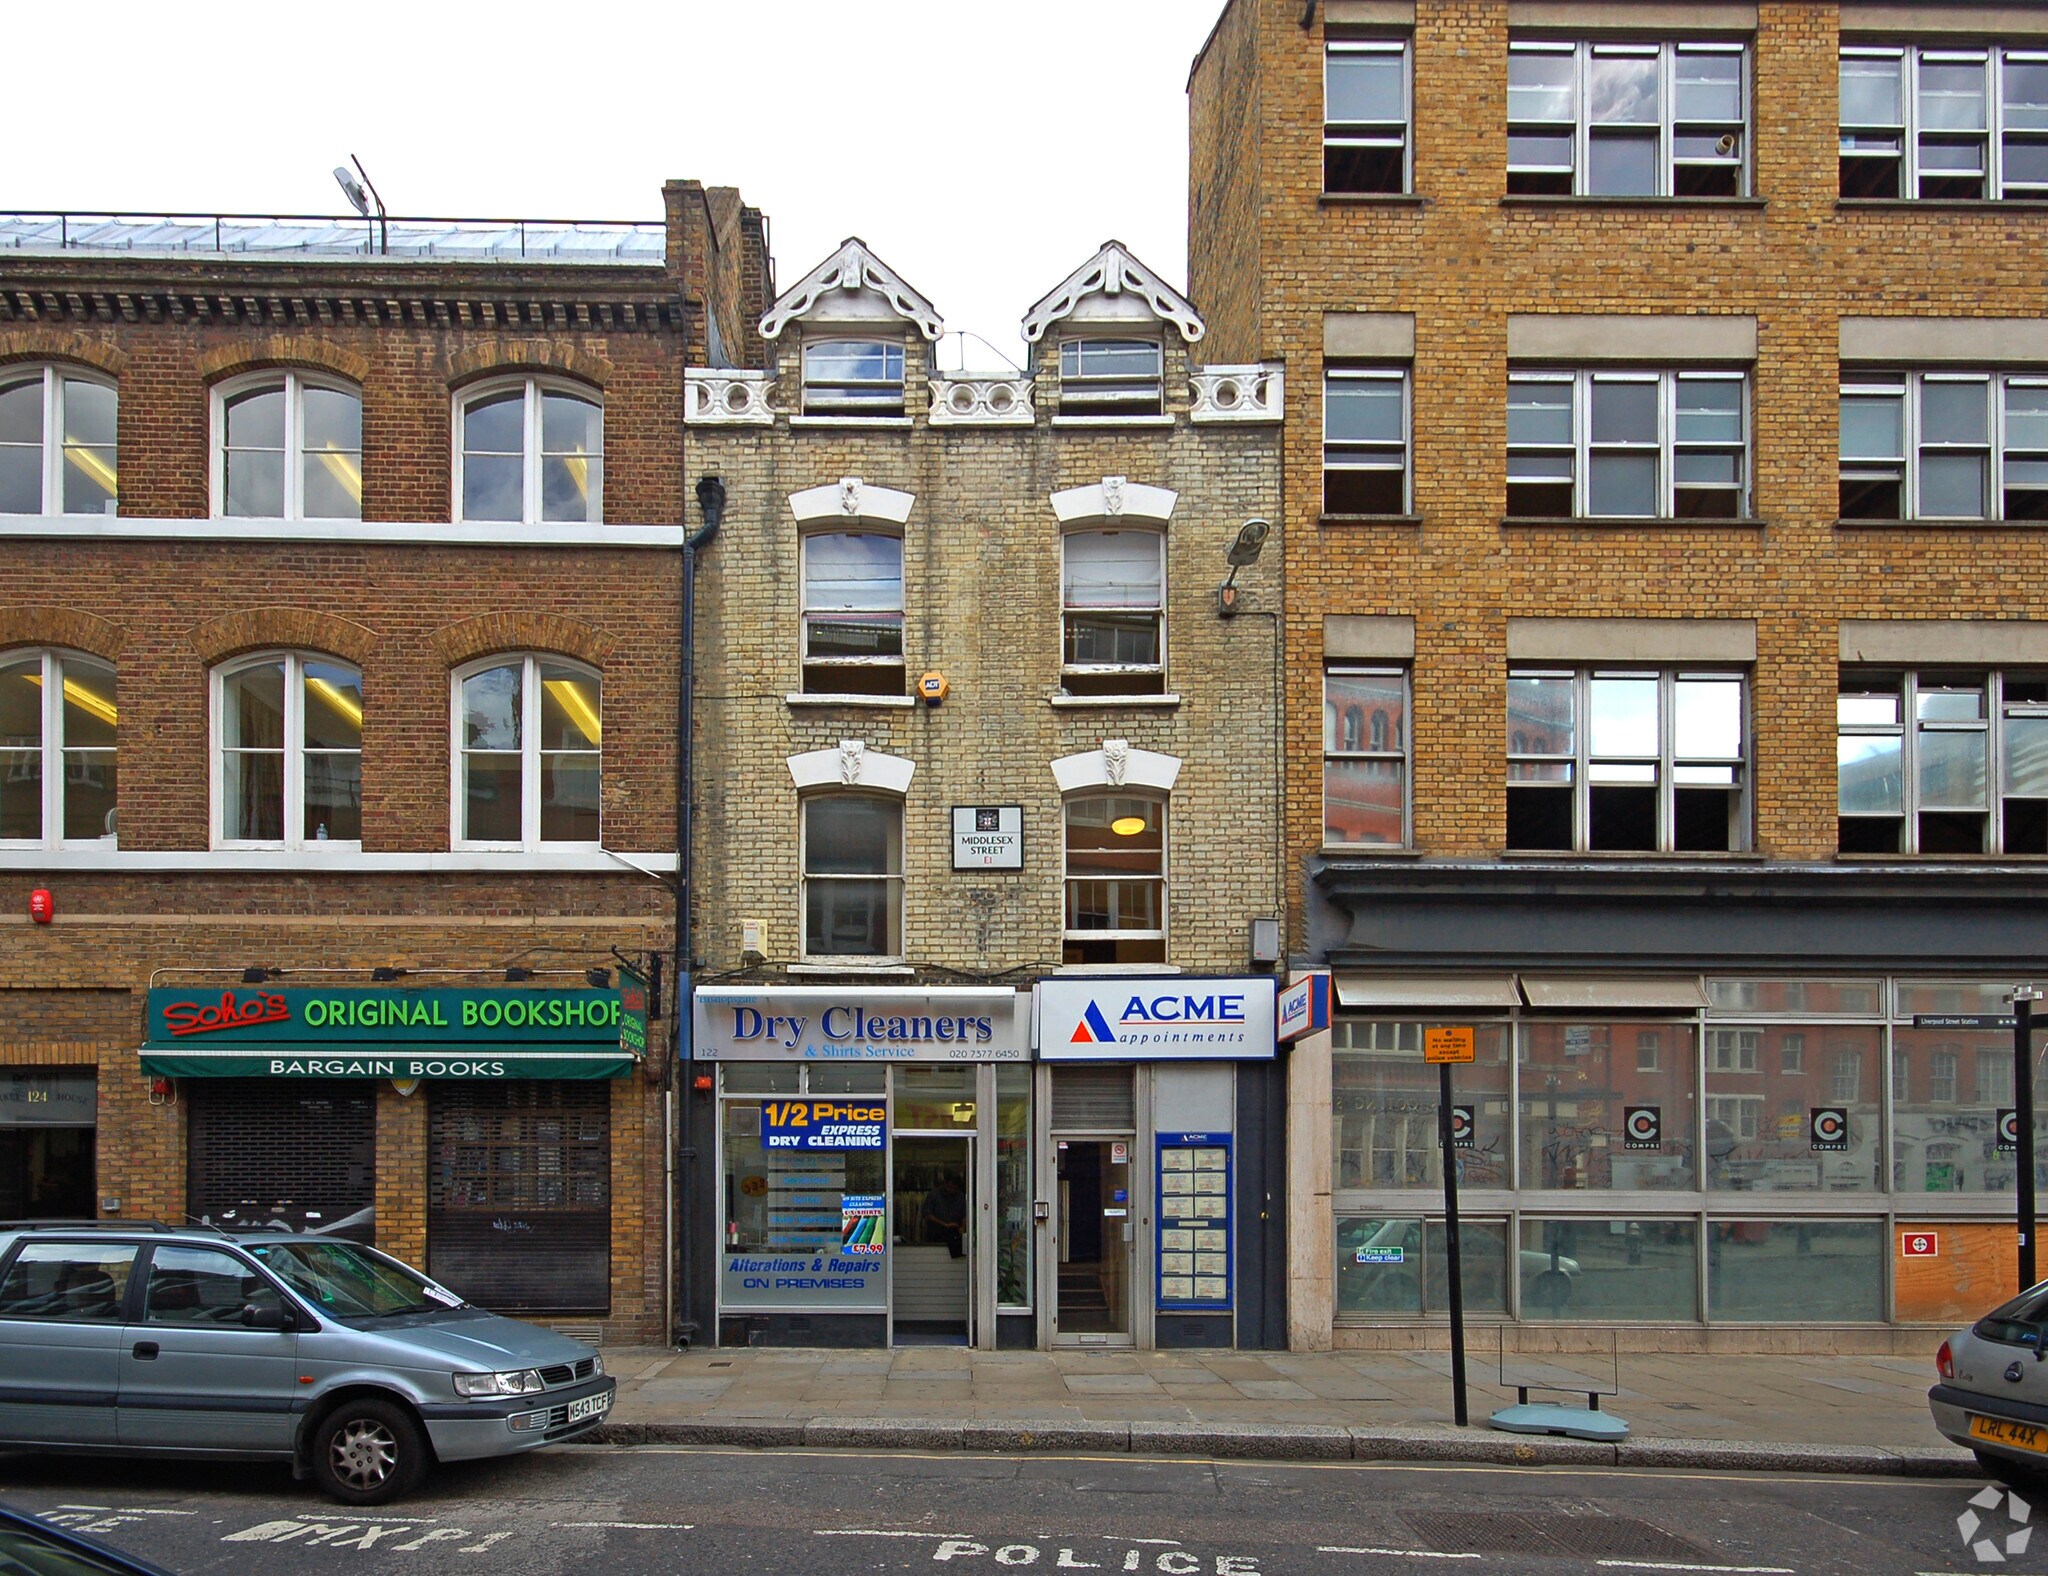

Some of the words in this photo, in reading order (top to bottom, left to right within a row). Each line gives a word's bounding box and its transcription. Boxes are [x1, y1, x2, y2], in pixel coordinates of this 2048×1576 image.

[961, 836, 1013, 844] MIDDLESEX
[970, 846, 1004, 854] STREET
[162, 991, 288, 1030] Soho's
[304, 999, 448, 1026] ORIGINAL
[1119, 994, 1245, 1020] ACME
[731, 1006, 808, 1049] Dry
[820, 1005, 993, 1041] Cleaners
[1119, 1030, 1245, 1045] appointments
[701, 1048, 718, 1057] 122
[804, 1044, 817, 1057] &
[822, 1043, 860, 1057] Shirts
[865, 1044, 915, 1058] Service
[949, 1049, 968, 1059] 020
[970, 1049, 993, 1059] 7377
[995, 1049, 1020, 1059] 6450
[269, 1060, 394, 1075] BARGAIN
[409, 1061, 505, 1076] BOOKS
[27, 1090, 47, 1103] 124
[765, 1102, 809, 1127] 1/2
[812, 1103, 885, 1121] Price
[820, 1125, 881, 1136] EXPRESS
[768, 1136, 801, 1146] DRY
[807, 1136, 882, 1147] CLEANING
[729, 1258, 806, 1272] Alterations
[811, 1258, 822, 1272] &
[827, 1258, 881, 1275] Repairs
[743, 1278, 770, 1289] ON
[775, 1278, 865, 1289] PREMISES
[1979, 1418, 2004, 1439] LRL
[932, 1540, 1262, 1576] POLICE
